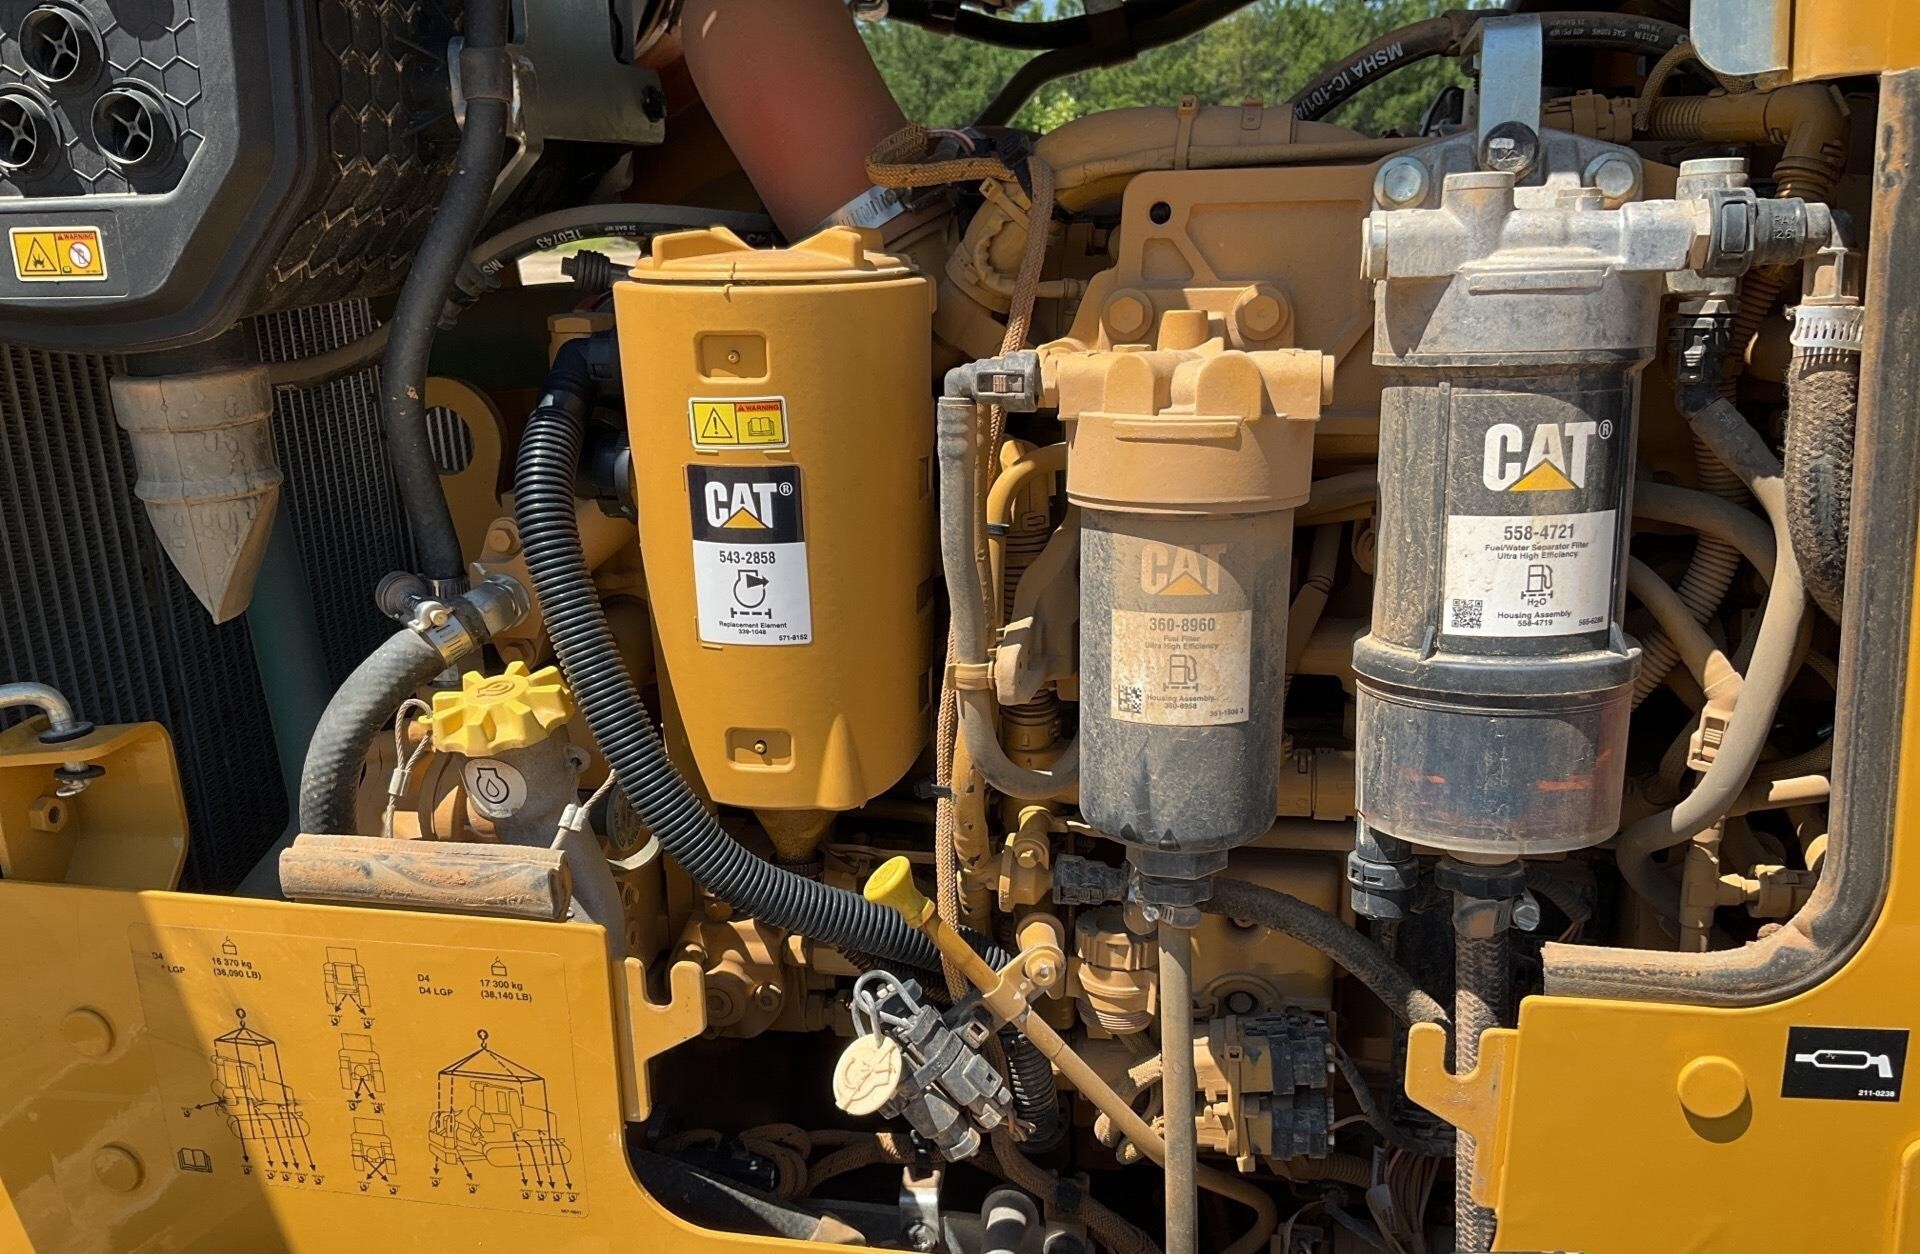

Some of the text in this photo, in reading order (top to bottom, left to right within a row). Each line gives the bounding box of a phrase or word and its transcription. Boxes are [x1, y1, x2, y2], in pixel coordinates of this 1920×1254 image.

[1350, 41, 1404, 78] MSHA
[535, 228, 584, 249] 1E0743
[1504, 523, 1575, 541] 558-4721
[1485, 541, 1589, 552] Fuel/Water Separator Filter
[719, 550, 776, 565] 543-2858
[1497, 551, 1578, 561] Ultra High Efficiency
[1141, 543, 1228, 595] CAT
[1497, 610, 1572, 620] Housing Assembly
[719, 620, 759, 628] Replacement
[1149, 617, 1216, 632] 360-8960
[1183, 642, 1219, 650] Efficiency
[1147, 694, 1178, 703] Housing
[224, 958, 239, 967] 370
[241, 960, 252, 970] kg
[246, 970, 262, 981] LB)
[417, 973, 430, 982] D4
[480, 979, 523, 991] 17 300 kg
[418, 986, 454, 996] D4 LGP
[480, 990, 532, 1003] (38,140 LB)
[1858, 1089, 1895, 1098] 211-0238
